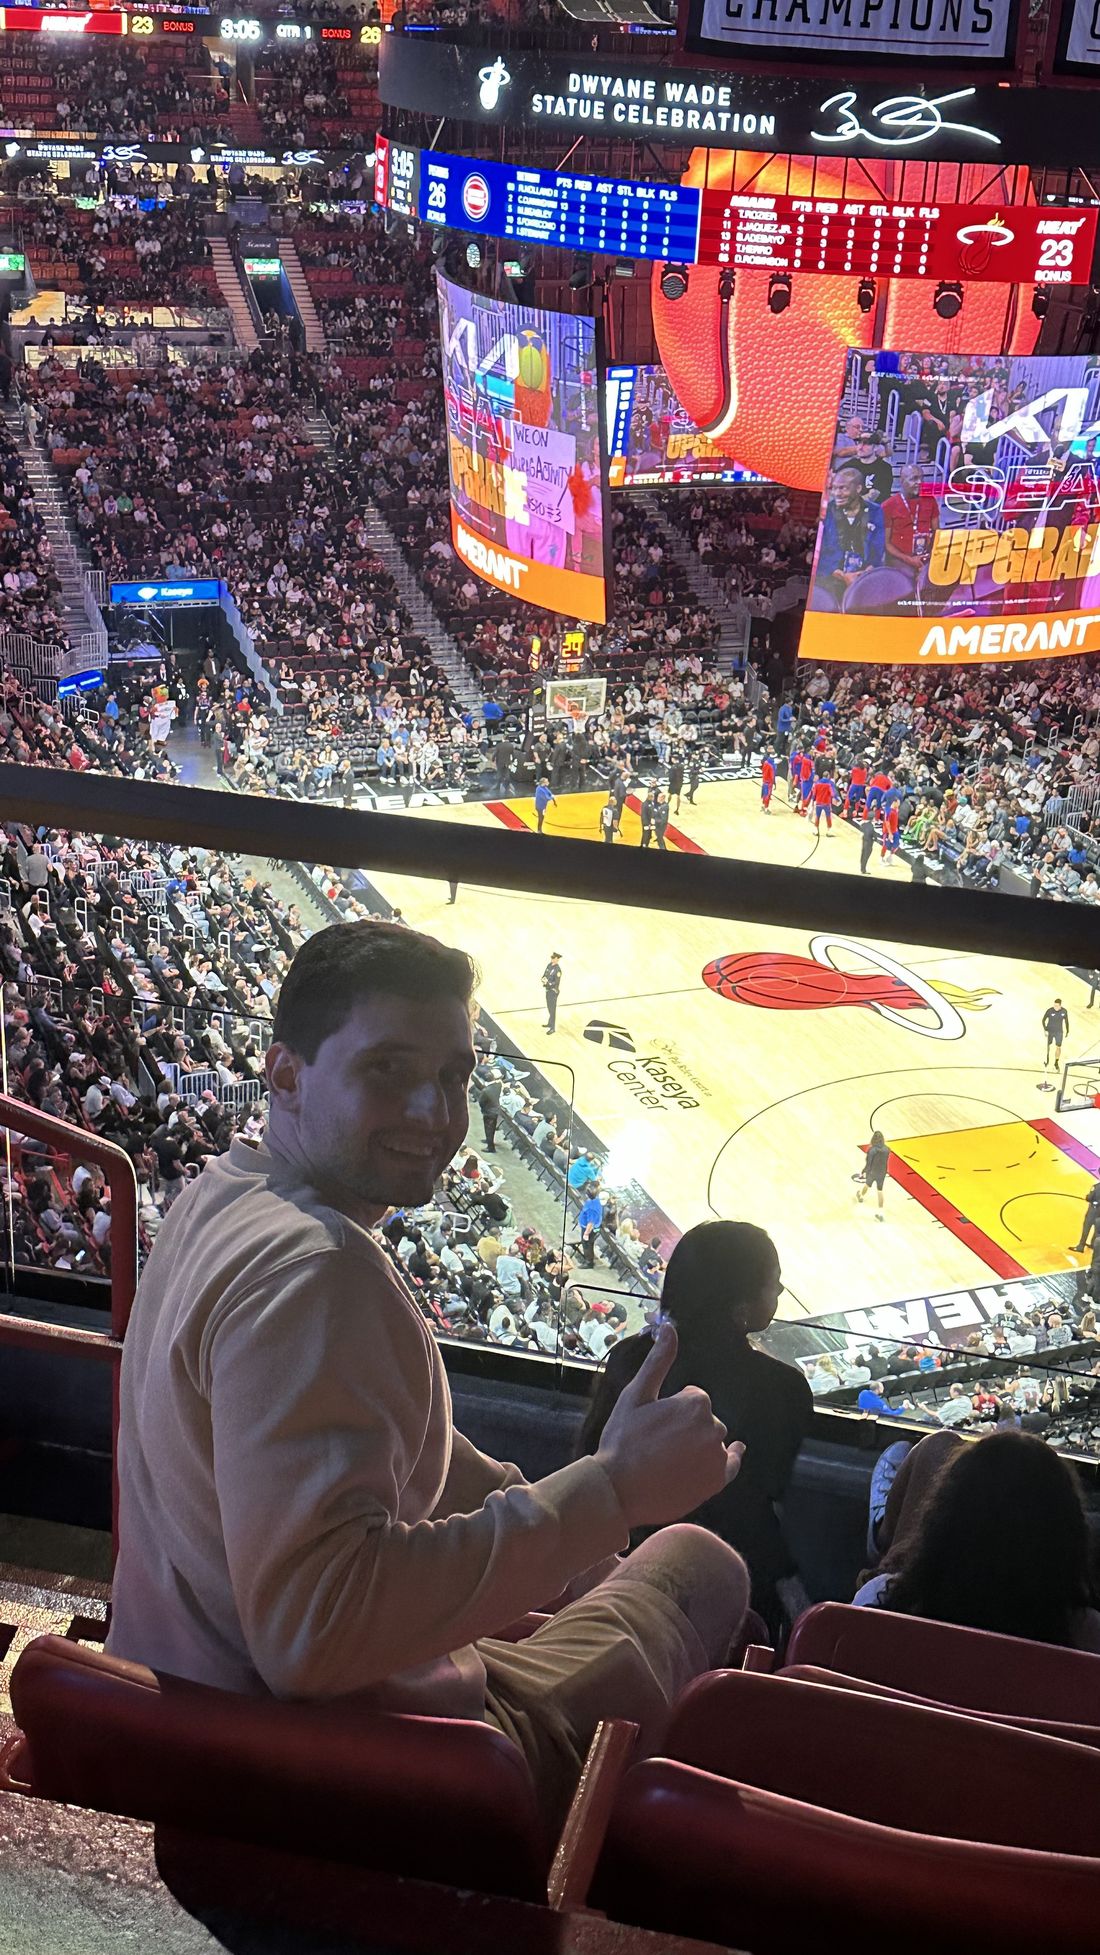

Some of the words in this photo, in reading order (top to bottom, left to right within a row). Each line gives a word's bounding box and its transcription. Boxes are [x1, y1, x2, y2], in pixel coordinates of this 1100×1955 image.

[131, 15, 154, 35] 23
[163, 21, 194, 33] BONUS
[220, 18, 260, 40] 3:05
[304, 25, 312, 39] 1
[321, 28, 352, 39] BONUS
[360, 25, 381, 44] 26
[568, 72, 657, 100] DWYANE
[665, 82, 731, 107] WADE
[532, 93, 605, 121] STATUE
[613, 102, 776, 136] CELEBRATION
[427, 181, 446, 208] 26
[556, 177, 572, 189] PTS
[596, 183, 613, 194] AST
[617, 184, 634, 197] STL
[637, 187, 655, 199] BLK
[659, 189, 678, 201] FLS
[792, 200, 812, 212] PTS
[843, 204, 865, 215] AST
[869, 205, 889, 217] STL
[892, 206, 915, 218] BLK
[919, 207, 940, 219] FLS
[1036, 217, 1086, 235] HEAT
[1038, 239, 1074, 267] 23
[1034, 269, 1072, 282] BONUS
[515, 425, 531, 444] WE
[532, 429, 549, 448] ON
[919, 615, 1100, 656] AMERANT
[607, 1060, 669, 1111] Center
[635, 1056, 700, 1110] Kaseya
